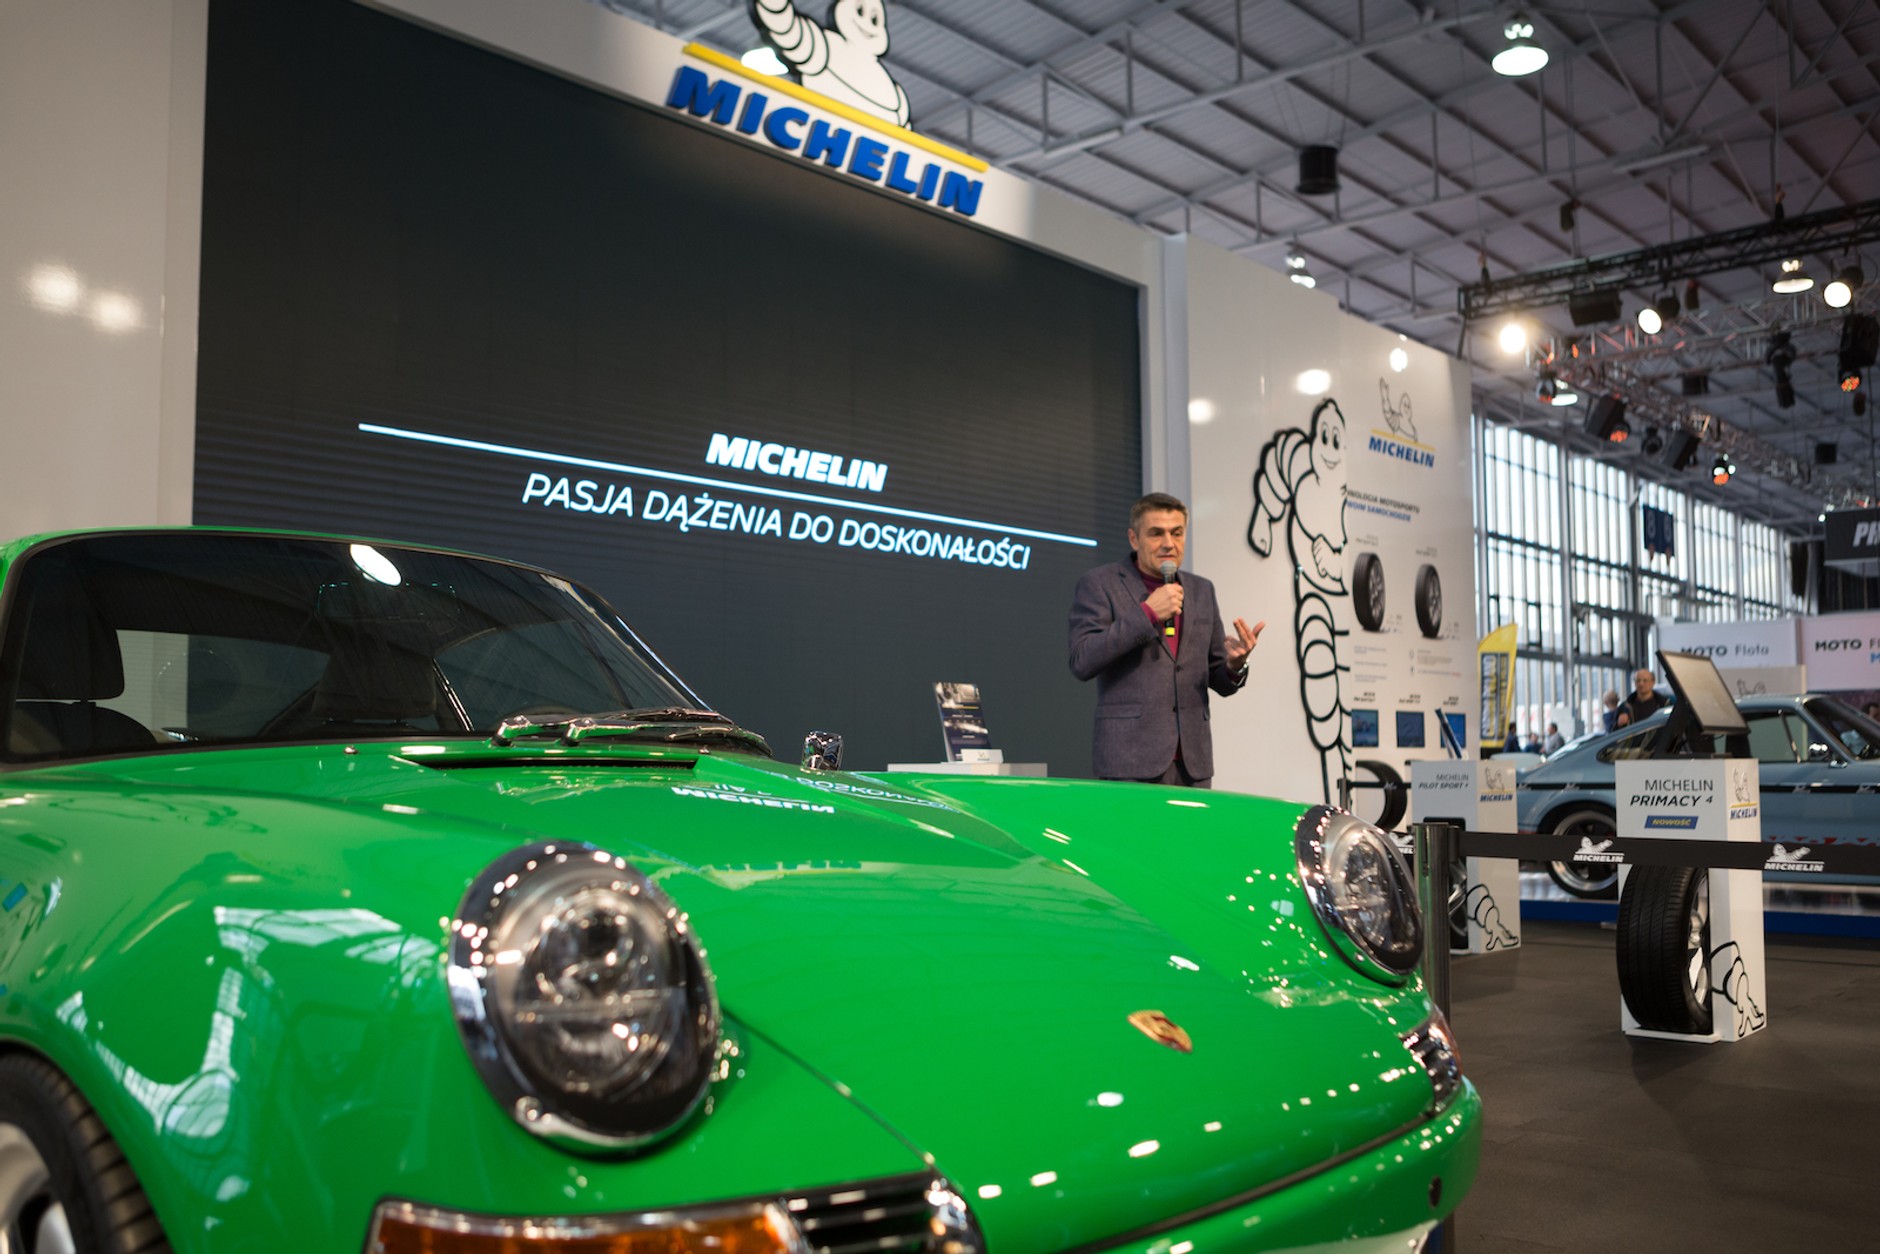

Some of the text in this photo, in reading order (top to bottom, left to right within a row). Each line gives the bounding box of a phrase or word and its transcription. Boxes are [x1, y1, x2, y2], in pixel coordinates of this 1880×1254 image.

[666, 65, 984, 217] MICHELIN
[1368, 436, 1435, 468] MICHELIN
[705, 433, 888, 492] MICHELIN
[522, 472, 1031, 570] PASJA DĄŻENIA DO DOSKONAŁOŚCI
[1815, 638, 1862, 652] MOTO
[1436, 773, 1469, 781] MICHELIN
[1644, 779, 1713, 791] MICHELIN
[1480, 794, 1513, 802] MICHELIN
[1630, 795, 1713, 807] PRIMACY 4
[1729, 808, 1757, 820] MICHELIN
[1573, 854, 1624, 863] MICHELIN
[1764, 862, 1824, 872] MICHELIN
